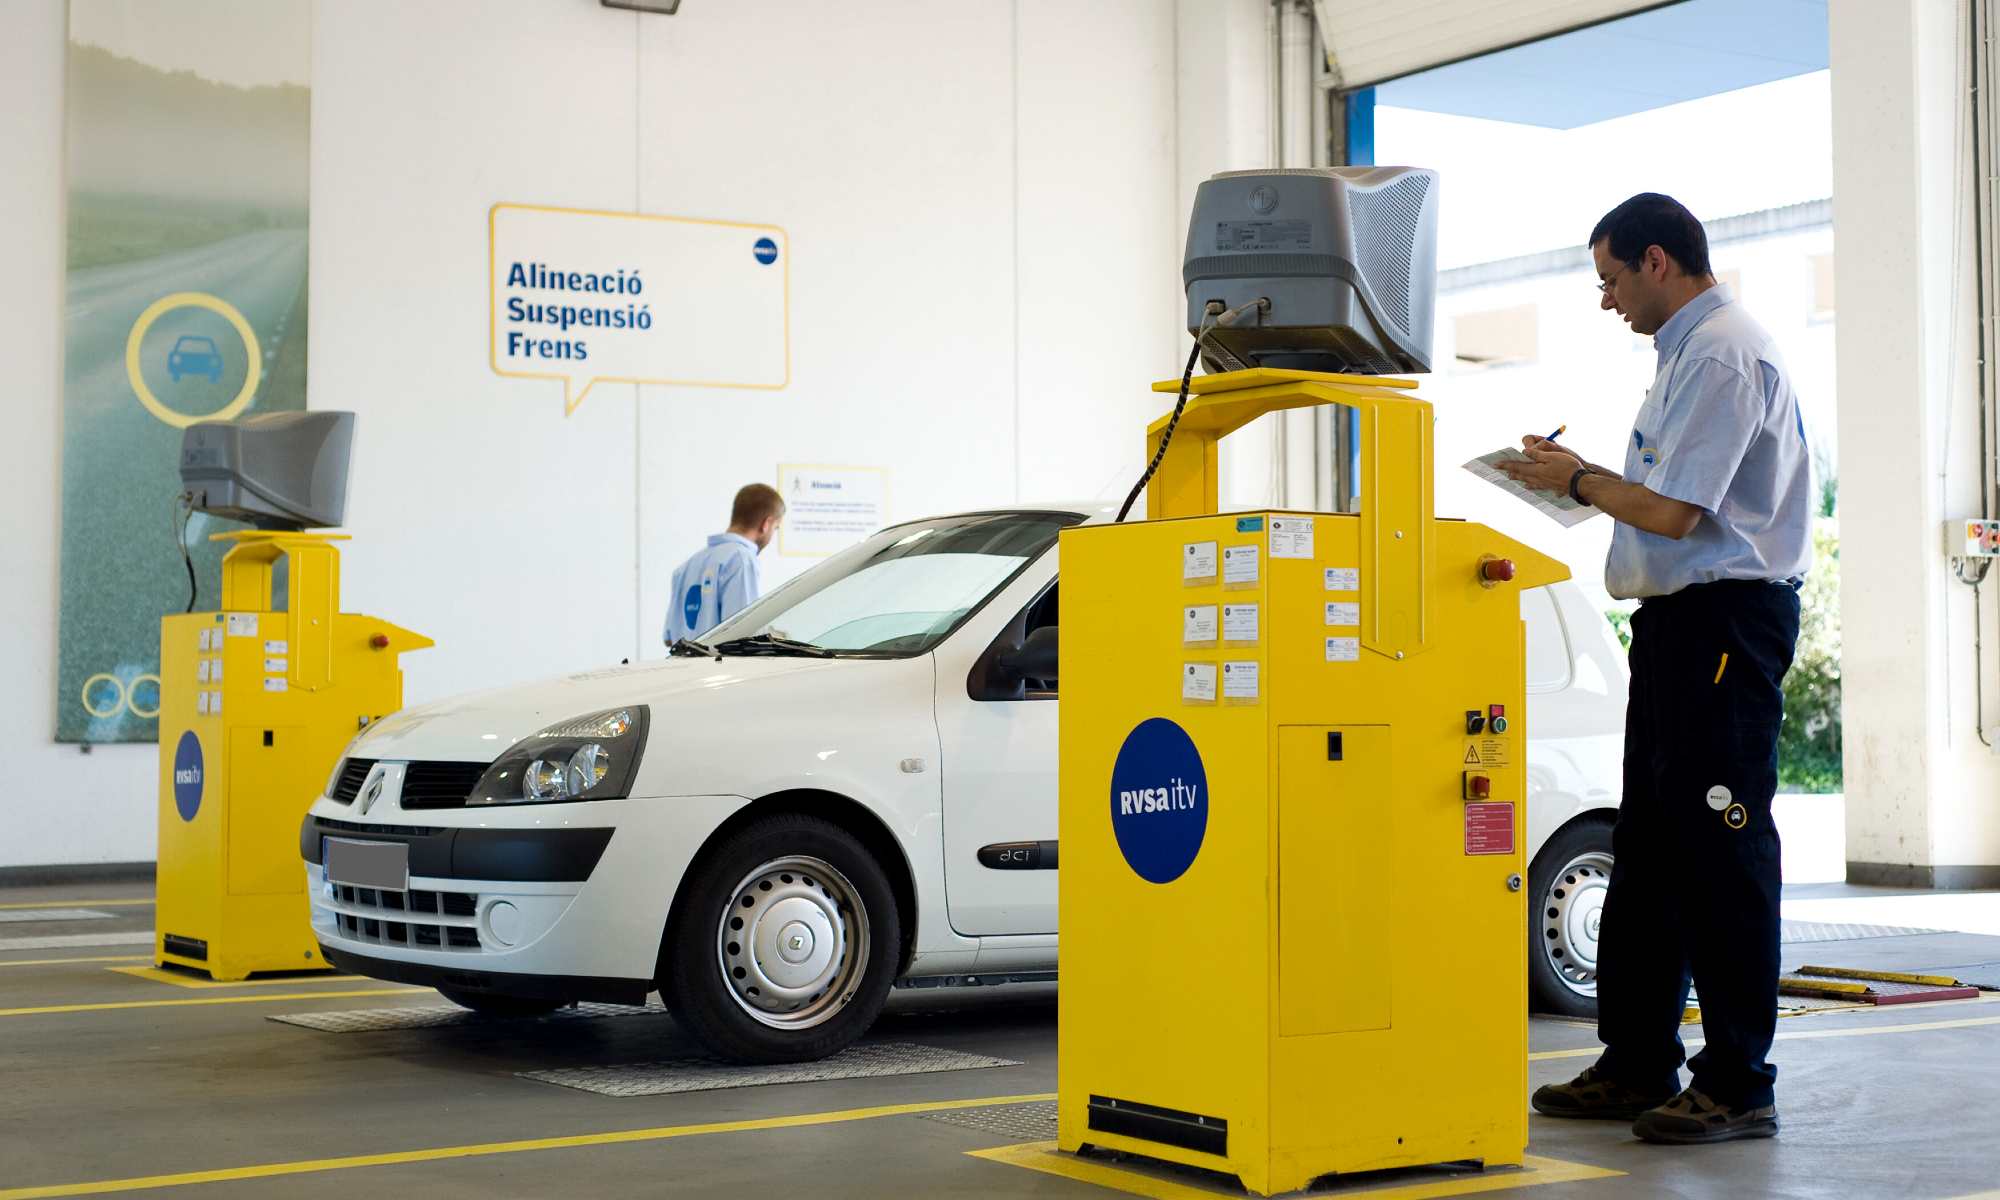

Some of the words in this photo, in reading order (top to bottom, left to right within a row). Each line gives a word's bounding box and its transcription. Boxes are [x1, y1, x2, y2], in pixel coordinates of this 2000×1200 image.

[507, 262, 643, 295] Alineació
[507, 296, 652, 331] Suspensió
[507, 331, 588, 360] Frens
